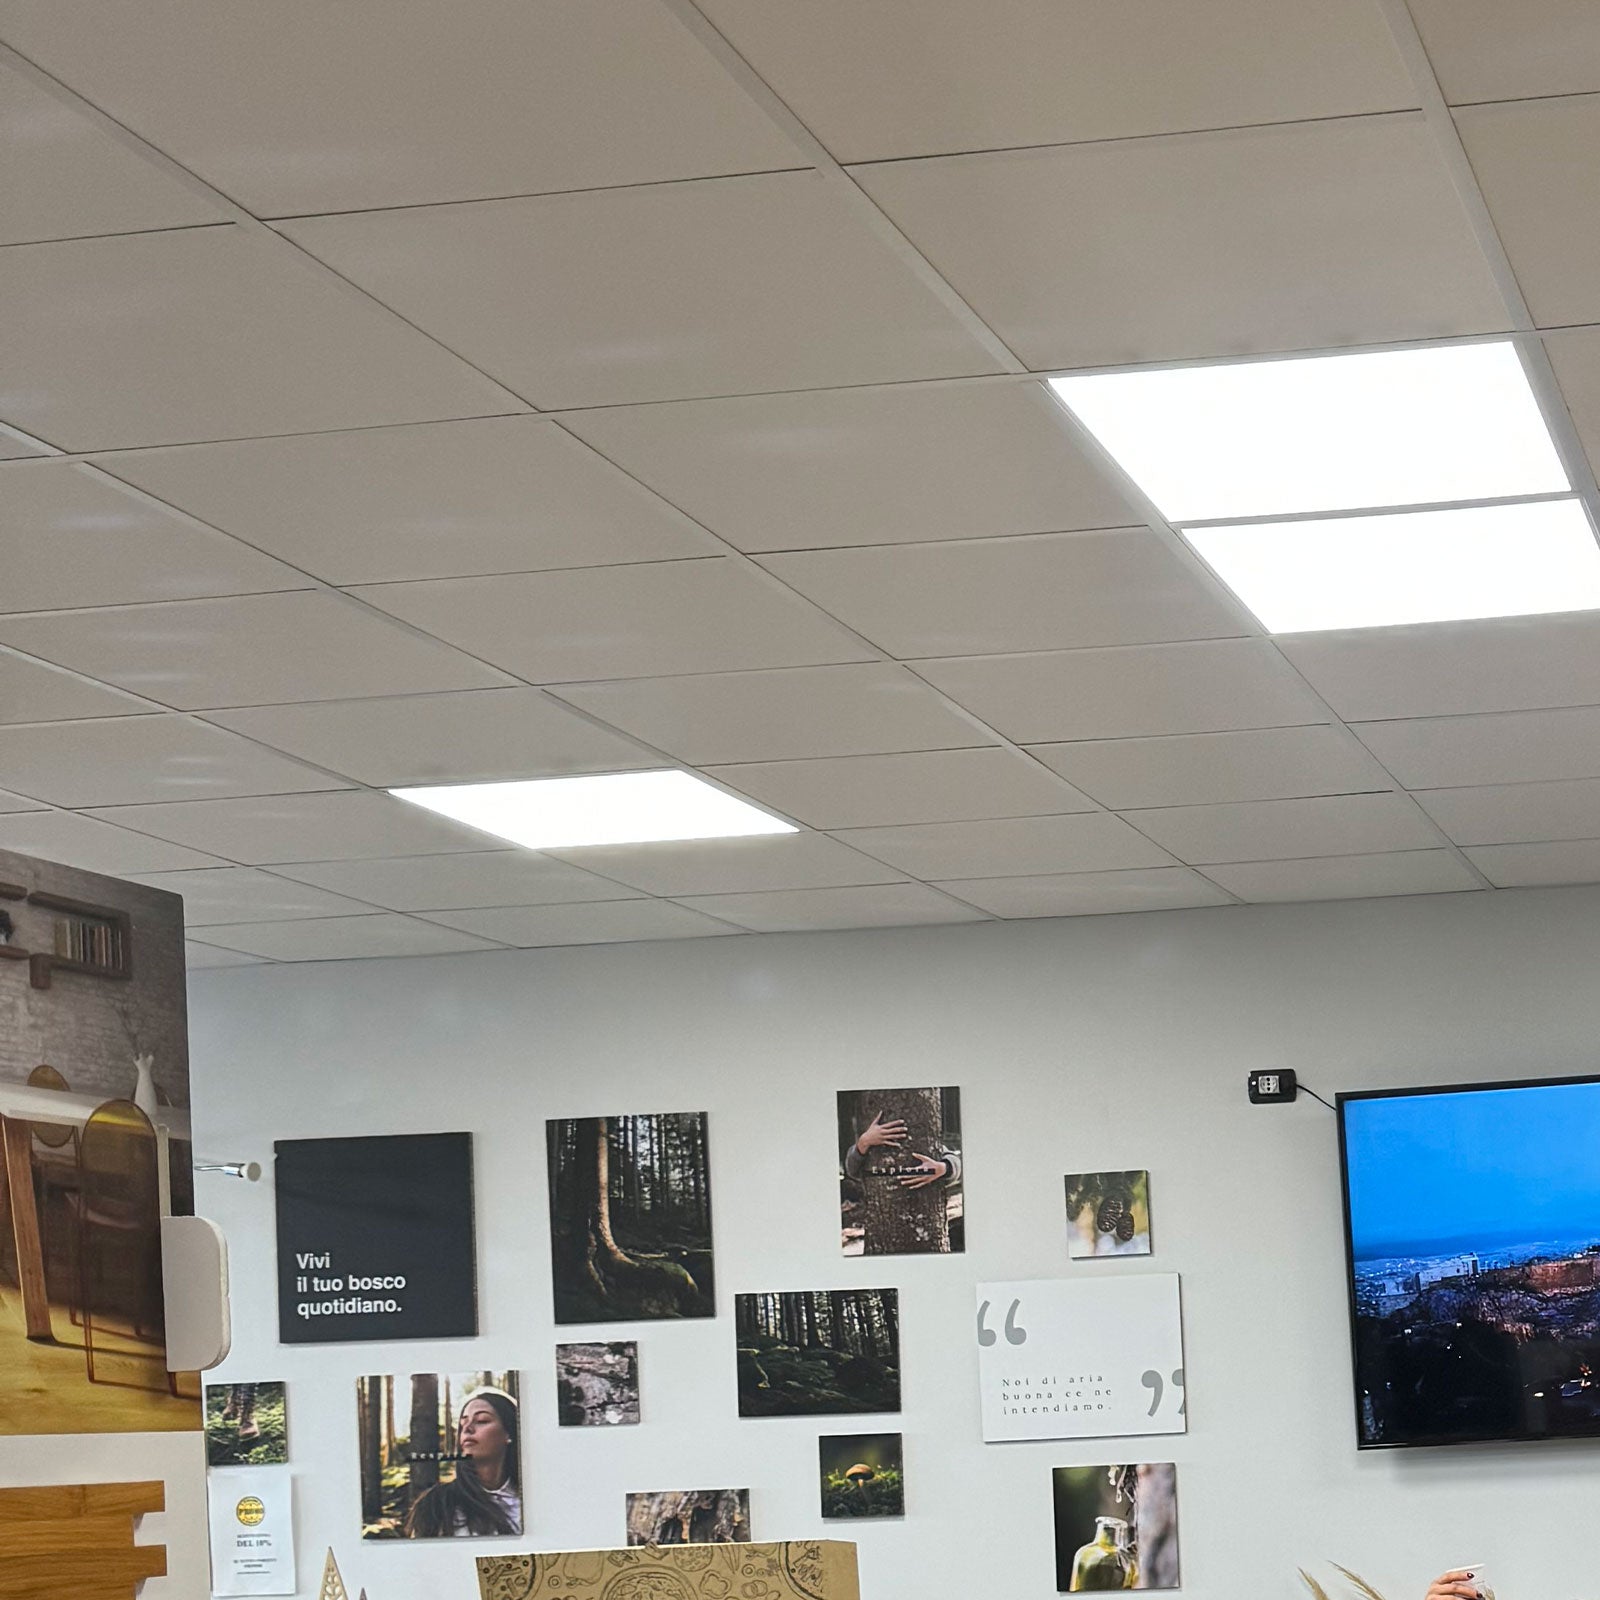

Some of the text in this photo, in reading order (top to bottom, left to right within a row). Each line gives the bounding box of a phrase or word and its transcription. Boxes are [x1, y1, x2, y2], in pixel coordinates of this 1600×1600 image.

[296, 1252, 330, 1269] Vivi
[297, 1274, 406, 1292] il tuo bosco
[297, 1297, 402, 1320] quotidiano.
[1002, 1374, 1104, 1387] Noi di aria
[1003, 1388, 1112, 1401] buona ce ne
[1003, 1402, 1112, 1415] intendiamo.
